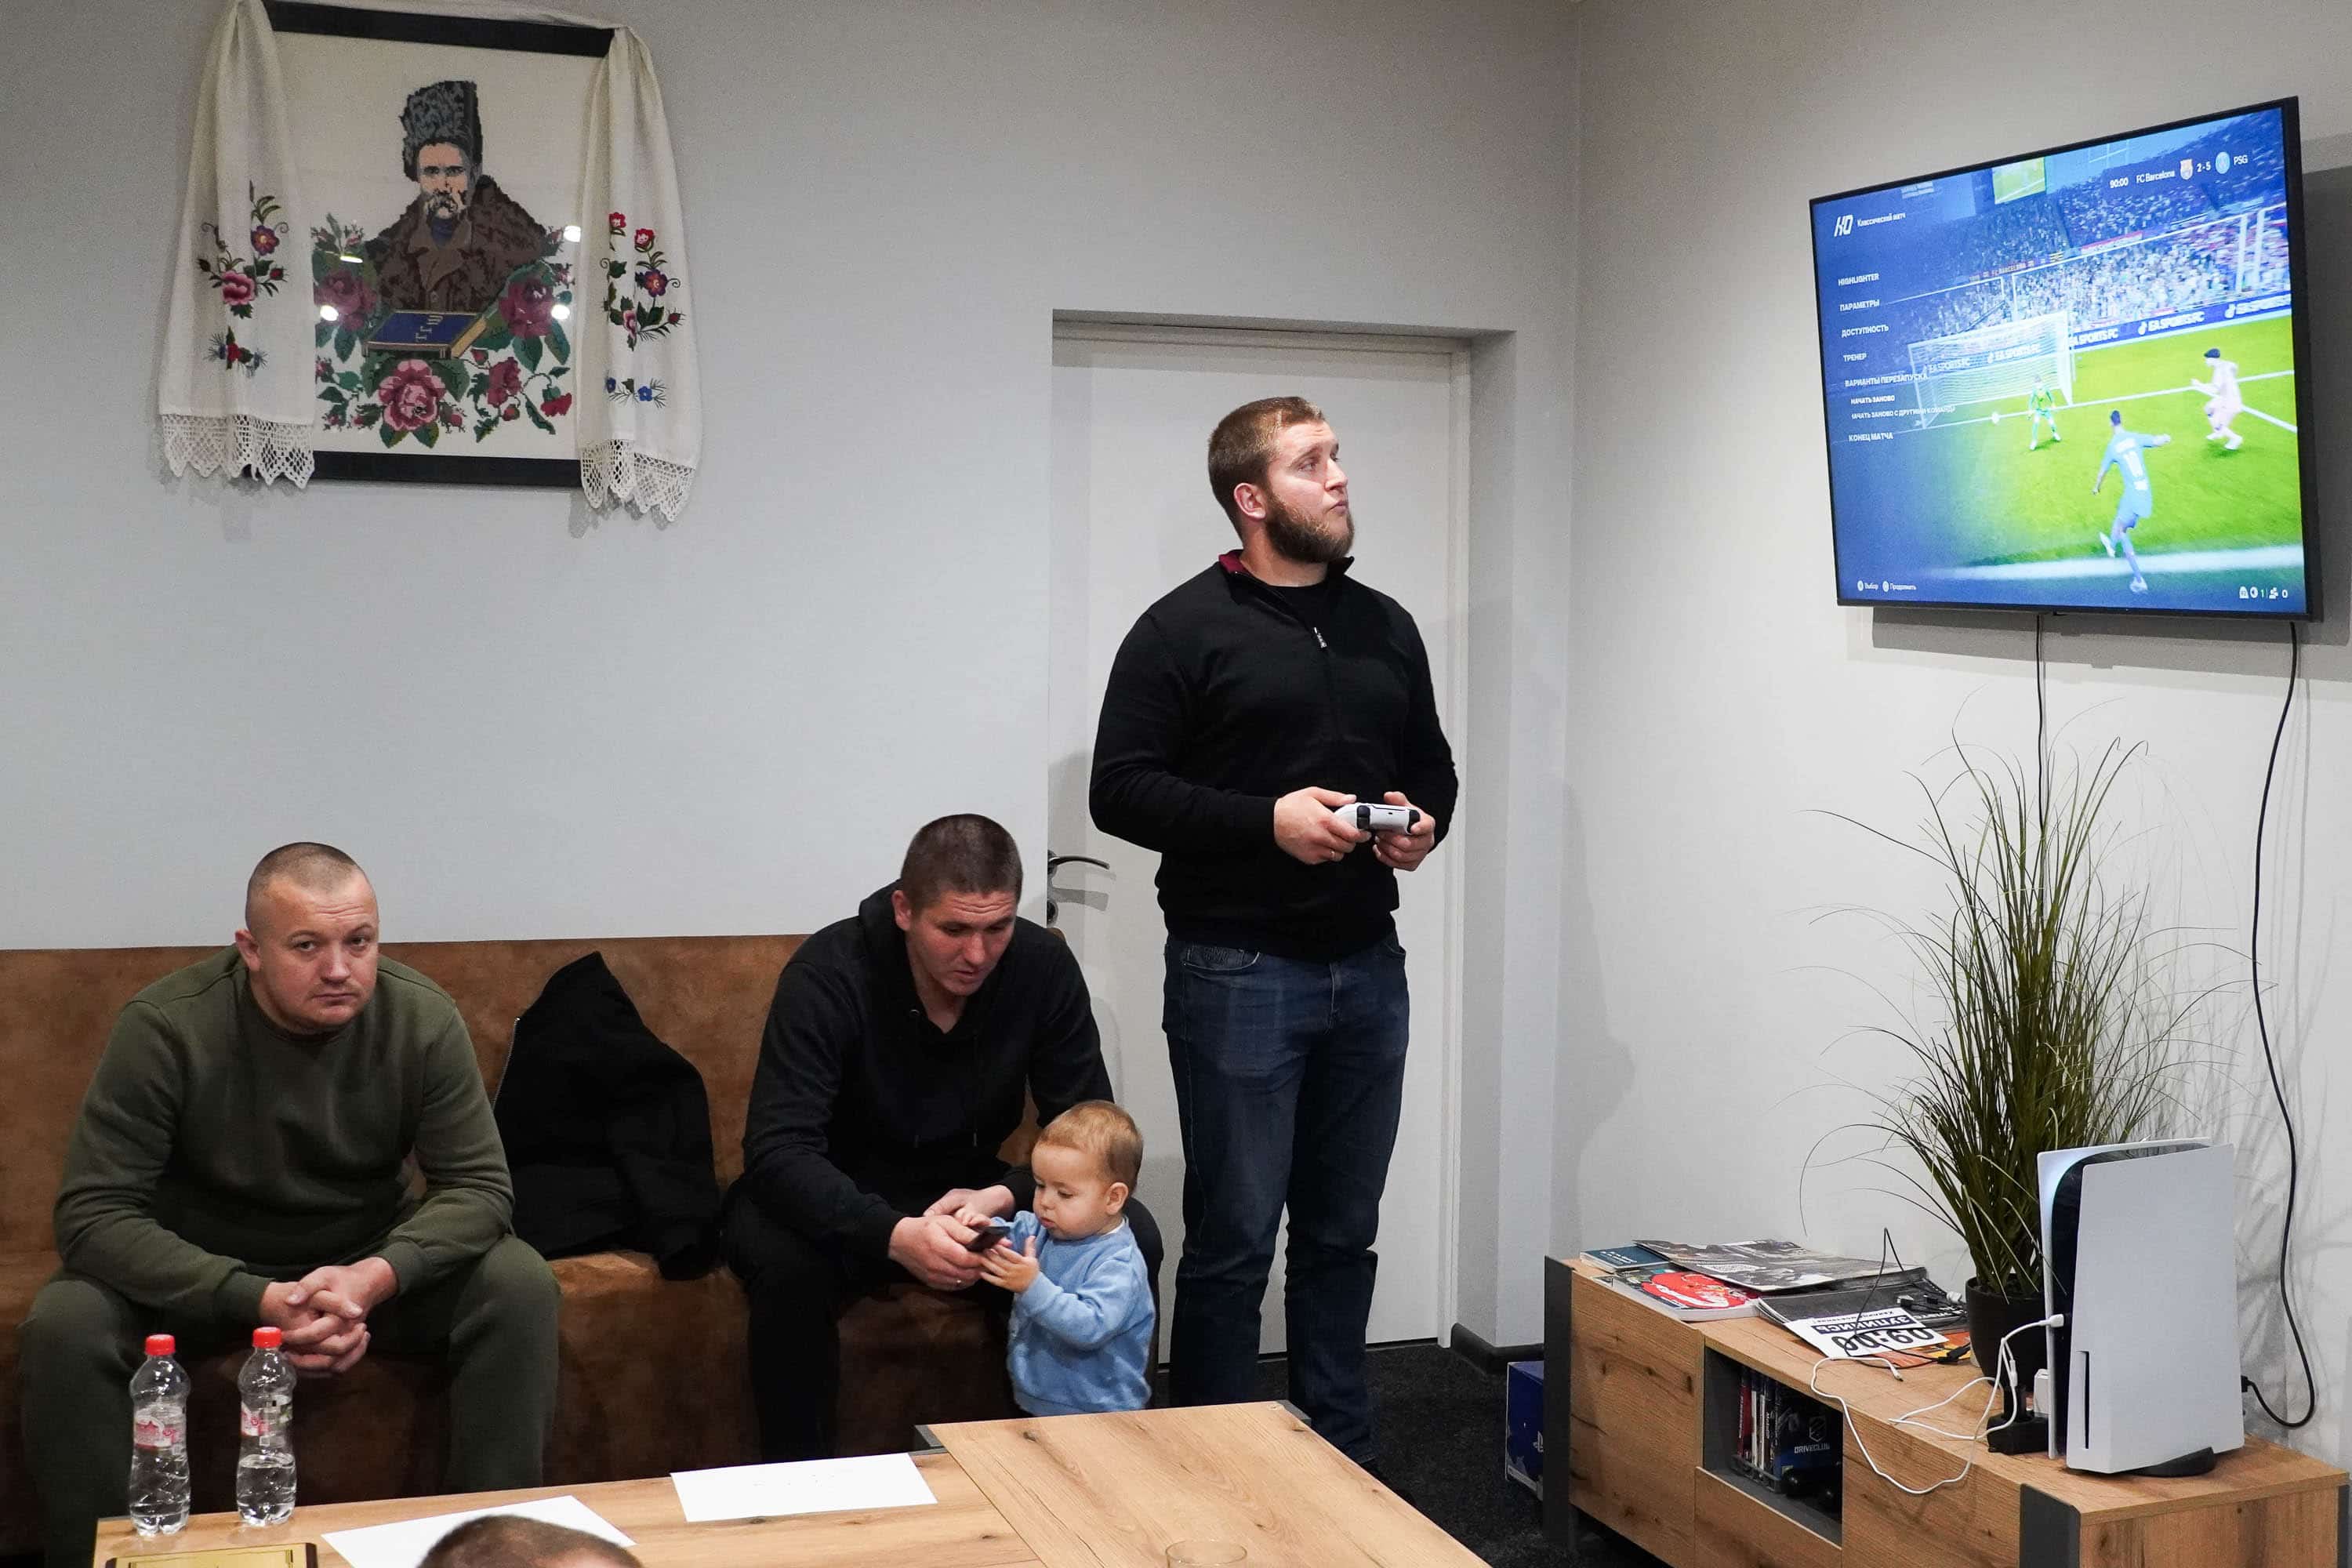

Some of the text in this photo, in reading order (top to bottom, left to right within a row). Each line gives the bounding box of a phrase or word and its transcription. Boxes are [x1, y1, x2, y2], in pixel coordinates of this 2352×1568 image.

[2234, 154, 2249, 165] PSG
[2136, 170, 2175, 183] FC Barcelona
[2110, 177, 2129, 189] 90:00
[1838, 273, 1880, 286] HIGHLIGHTER
[1839, 299, 1880, 311] ПАРАМЕТРЫ
[1842, 325, 1889, 338] ДОСТУПНОСТЬ
[1843, 353, 1867, 362] ТРЕНЕР
[1845, 372, 1929, 387] ВАРИАНТЫ ПЕРЕЗАПУСКА
[1872, 395, 1895, 404] ЗАНОВО
[1899, 407, 1926, 416] ДРУГИМИ
[1849, 432, 1893, 442] КОНЕЦ МАТЧА
[1815, 1316, 1911, 1332] ЗУПИНИСЬ
[1831, 1327, 1935, 1351] 09:00
